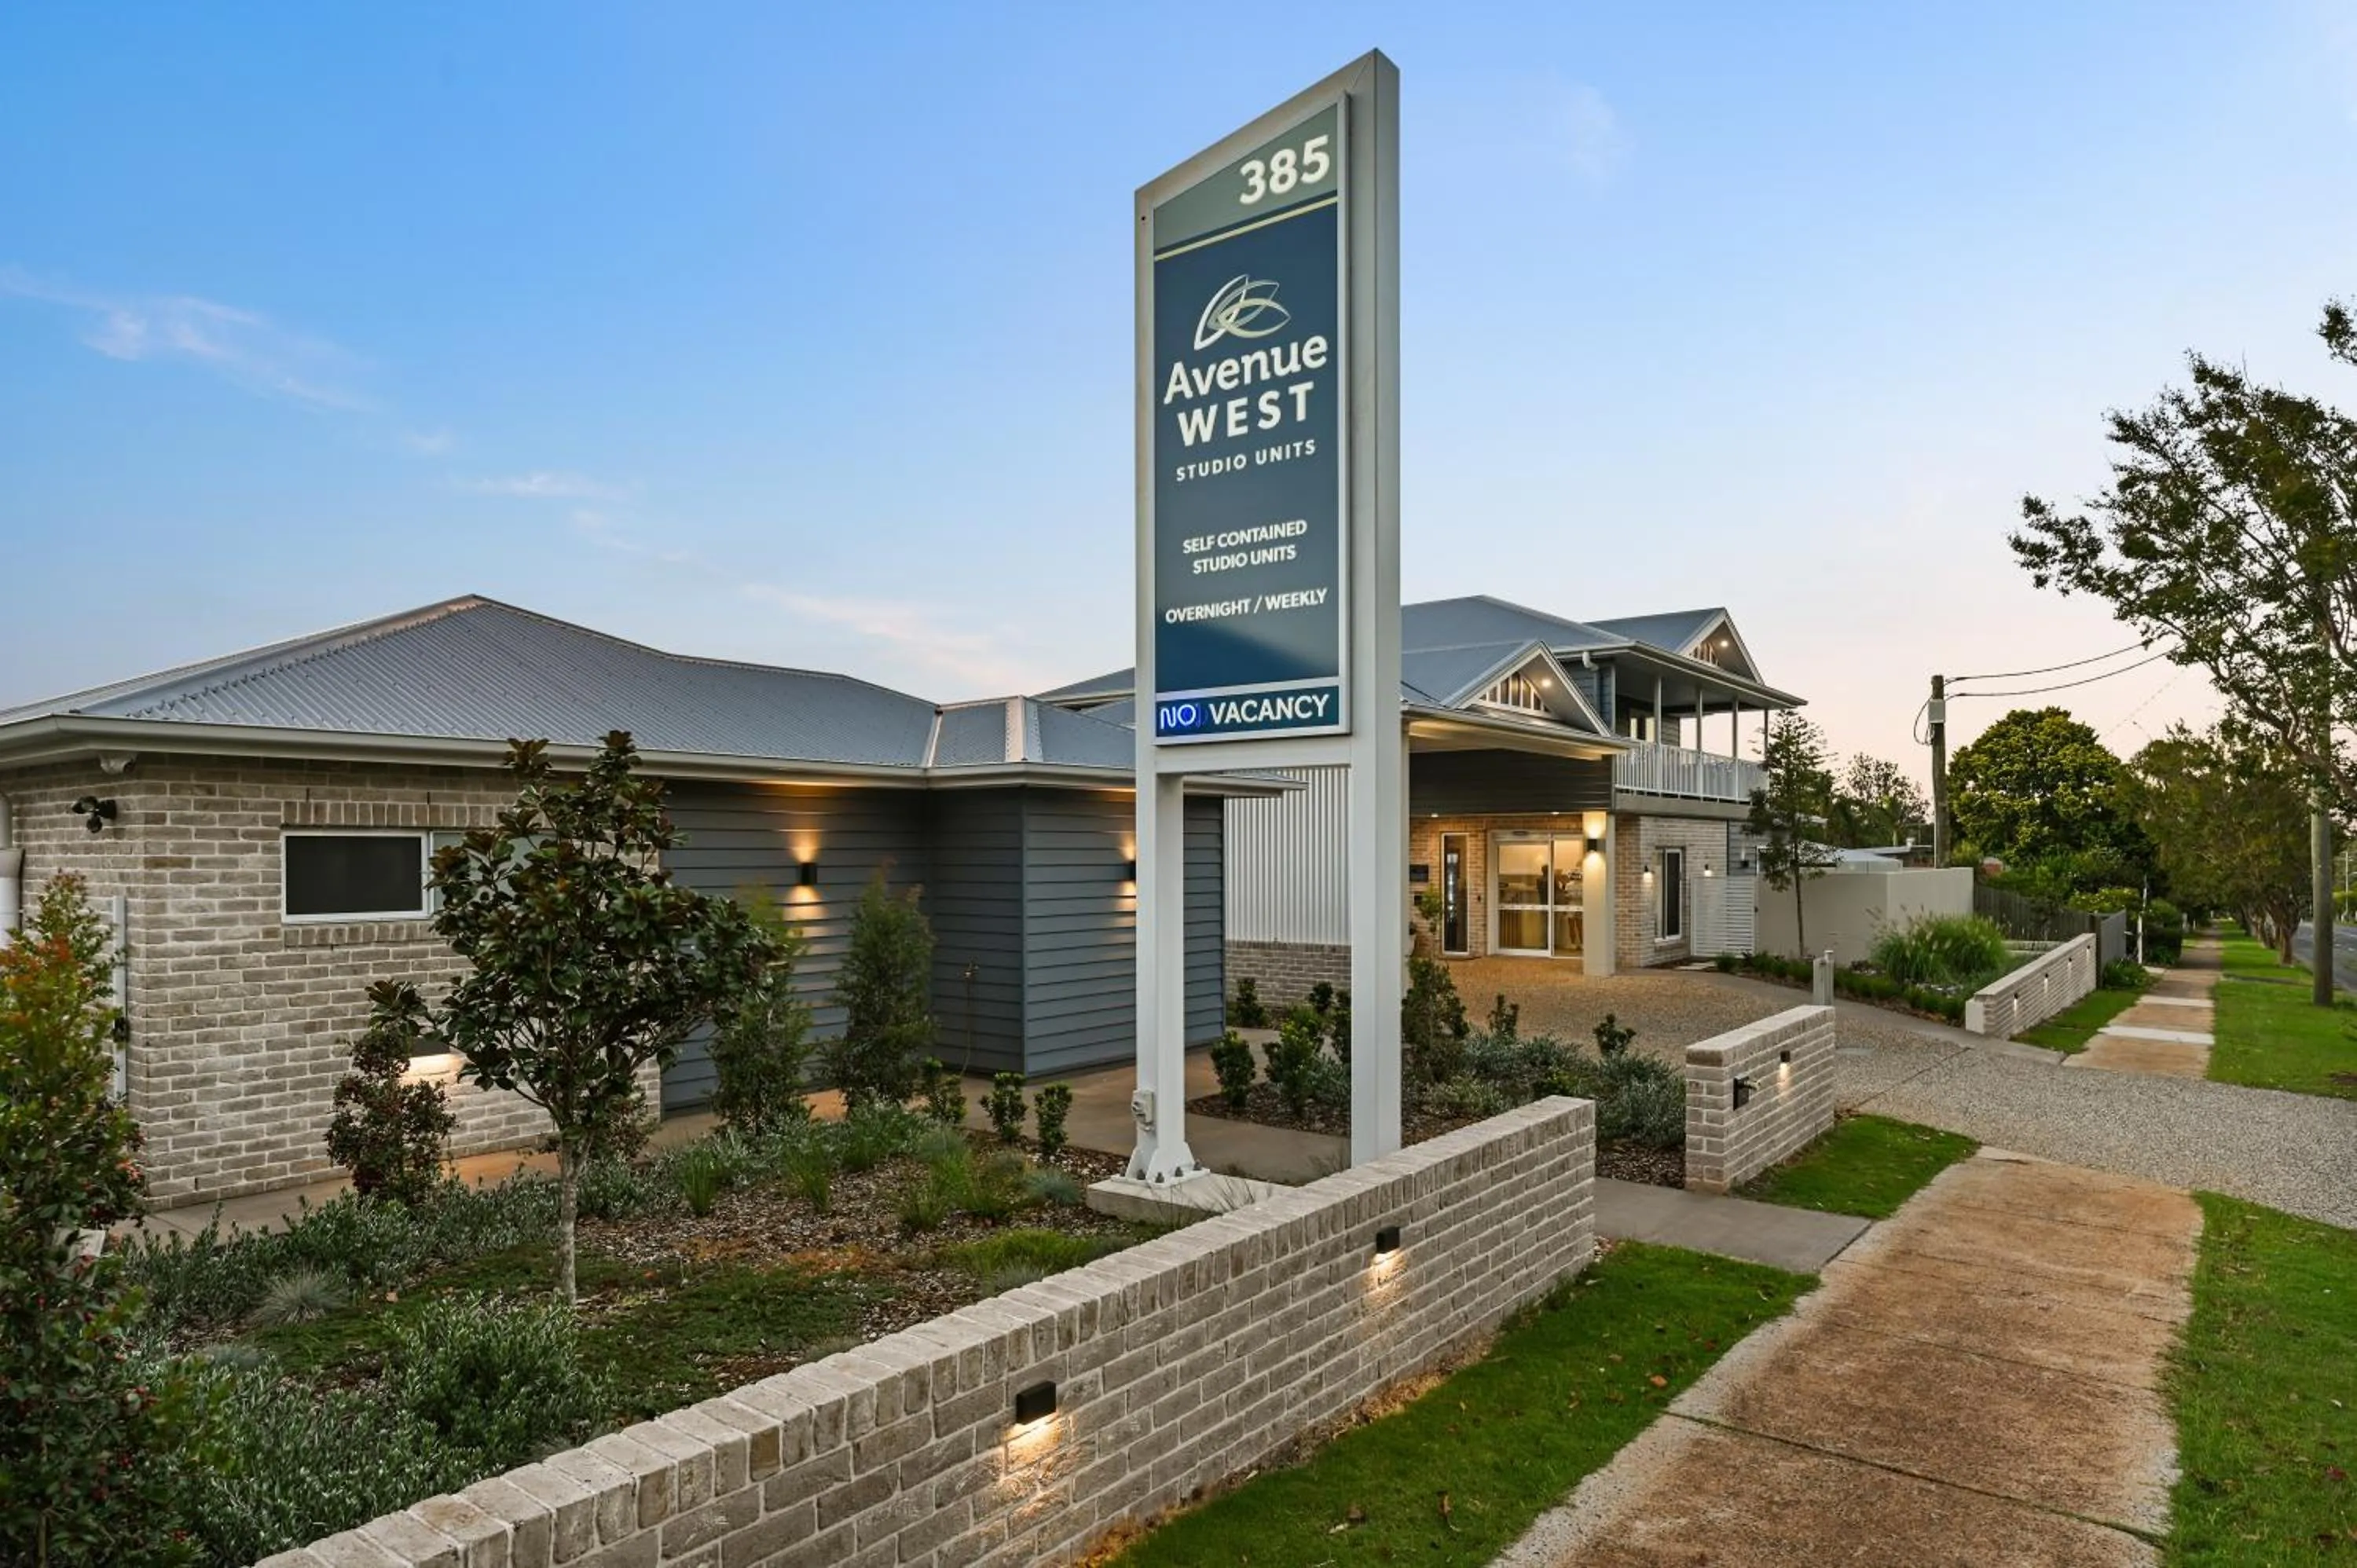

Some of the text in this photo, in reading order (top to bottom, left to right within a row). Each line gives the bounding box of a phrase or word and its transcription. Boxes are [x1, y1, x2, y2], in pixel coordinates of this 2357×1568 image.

[1239, 134, 1331, 205] 385
[1163, 335, 1329, 405] Avenue
[1177, 382, 1314, 447] WEST
[1175, 439, 1317, 482] STUDIO UNITS
[1182, 519, 1307, 554] SELF CONTAINED
[1193, 544, 1296, 574] STUDIO UNITS
[1165, 598, 1252, 624] OVERNIGHT
[1265, 588, 1328, 610] WEEKLY
[1160, 694, 1329, 729] NO VACANCY
